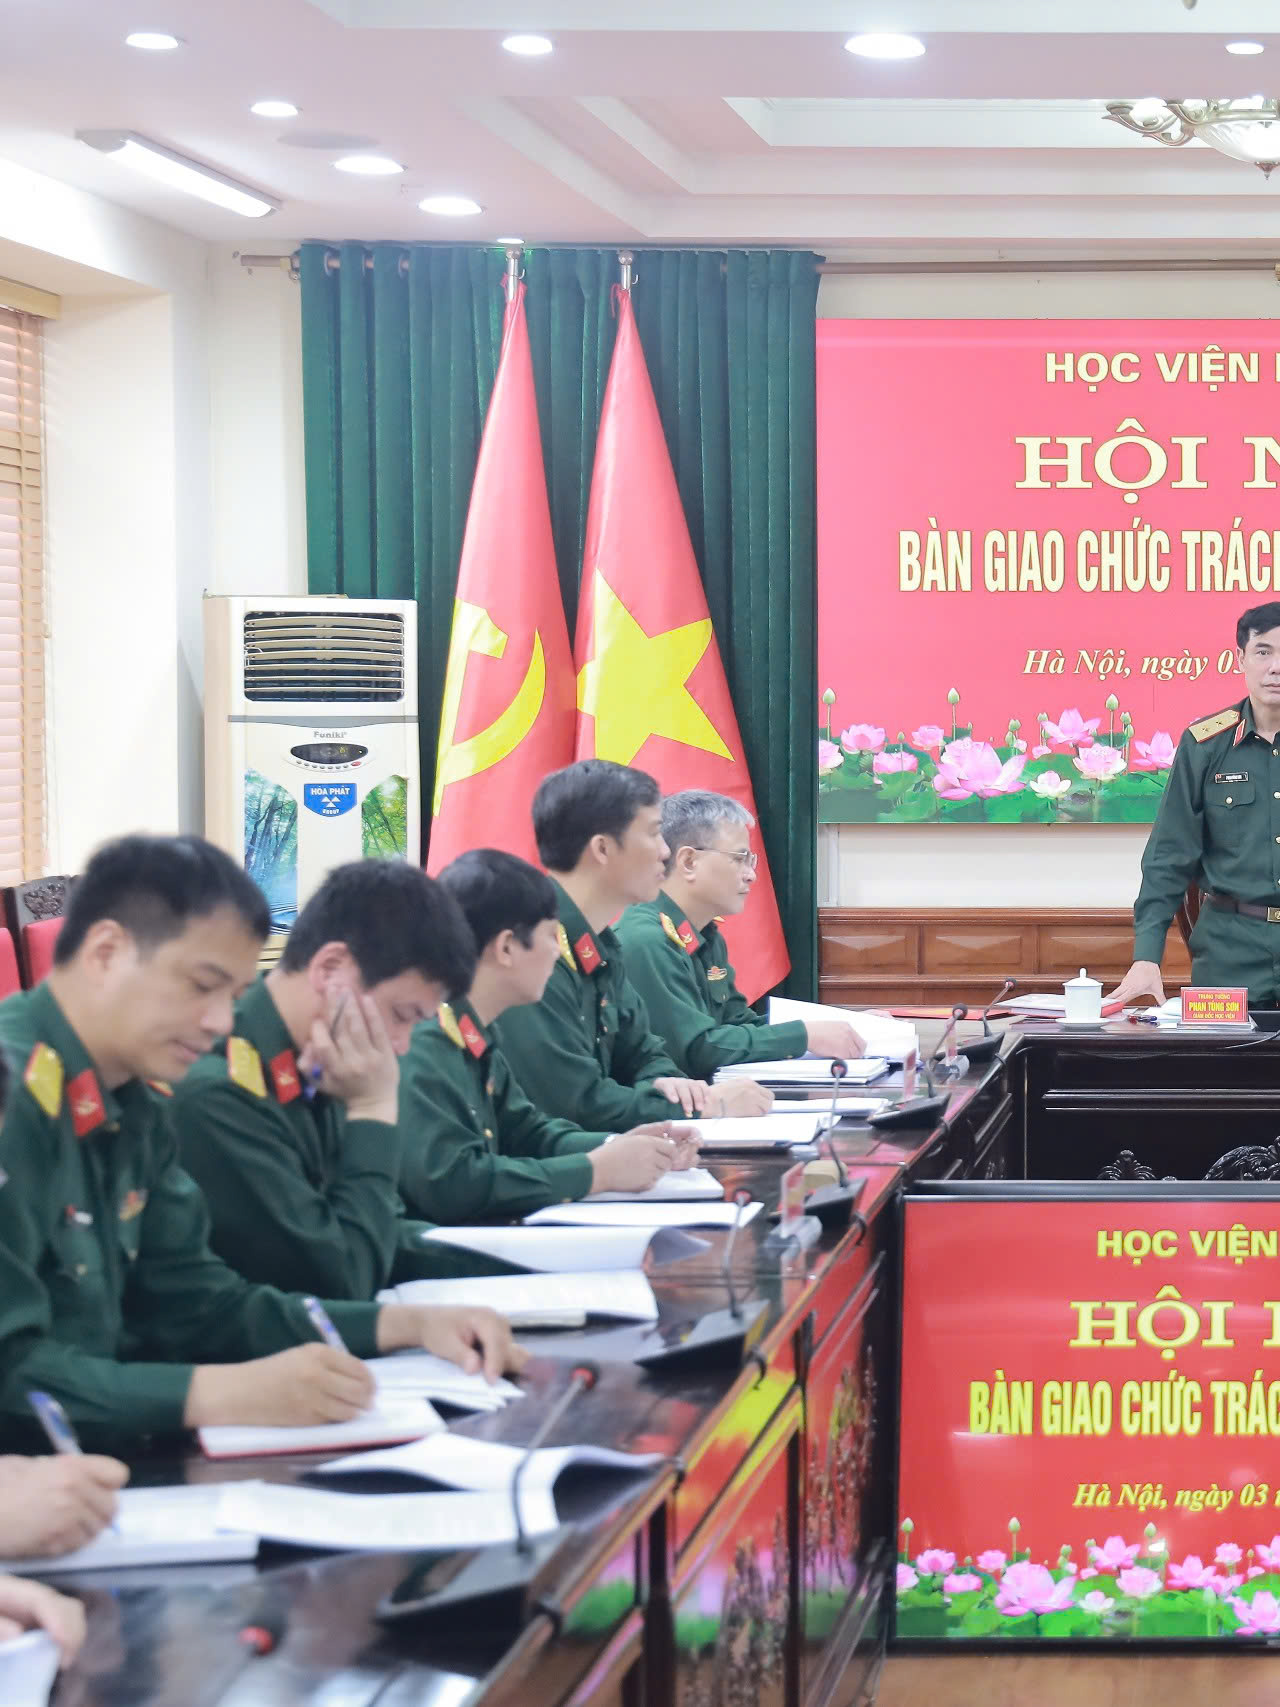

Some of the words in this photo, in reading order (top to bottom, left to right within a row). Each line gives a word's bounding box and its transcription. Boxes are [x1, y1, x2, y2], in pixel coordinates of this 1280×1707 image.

[1046, 352, 1140, 393] HỌC
[1154, 344, 1259, 392] VIỆN
[1014, 417, 1208, 504] HỘI
[898, 517, 972, 592] BÀN
[983, 529, 1065, 593] GIAO
[1076, 517, 1170, 593] CHỨC
[1023, 649, 1065, 674] Hà
[1073, 649, 1131, 681] Nội,
[1141, 649, 1209, 681] ngày
[1217, 649, 1243, 674] 0
[1096, 1229, 1179, 1266] HỌC
[1188, 1223, 1278, 1265] VIỆN
[1067, 1284, 1236, 1361] HỘI
[968, 1369, 1034, 1437] BÀN
[1041, 1379, 1113, 1437] GIAO
[1119, 1369, 1202, 1437] CHỨC
[1071, 1483, 1112, 1508] Hà
[1115, 1483, 1168, 1513] Nội,
[1173, 1483, 1235, 1513] ngày
[1239, 1483, 1270, 1507] 03
